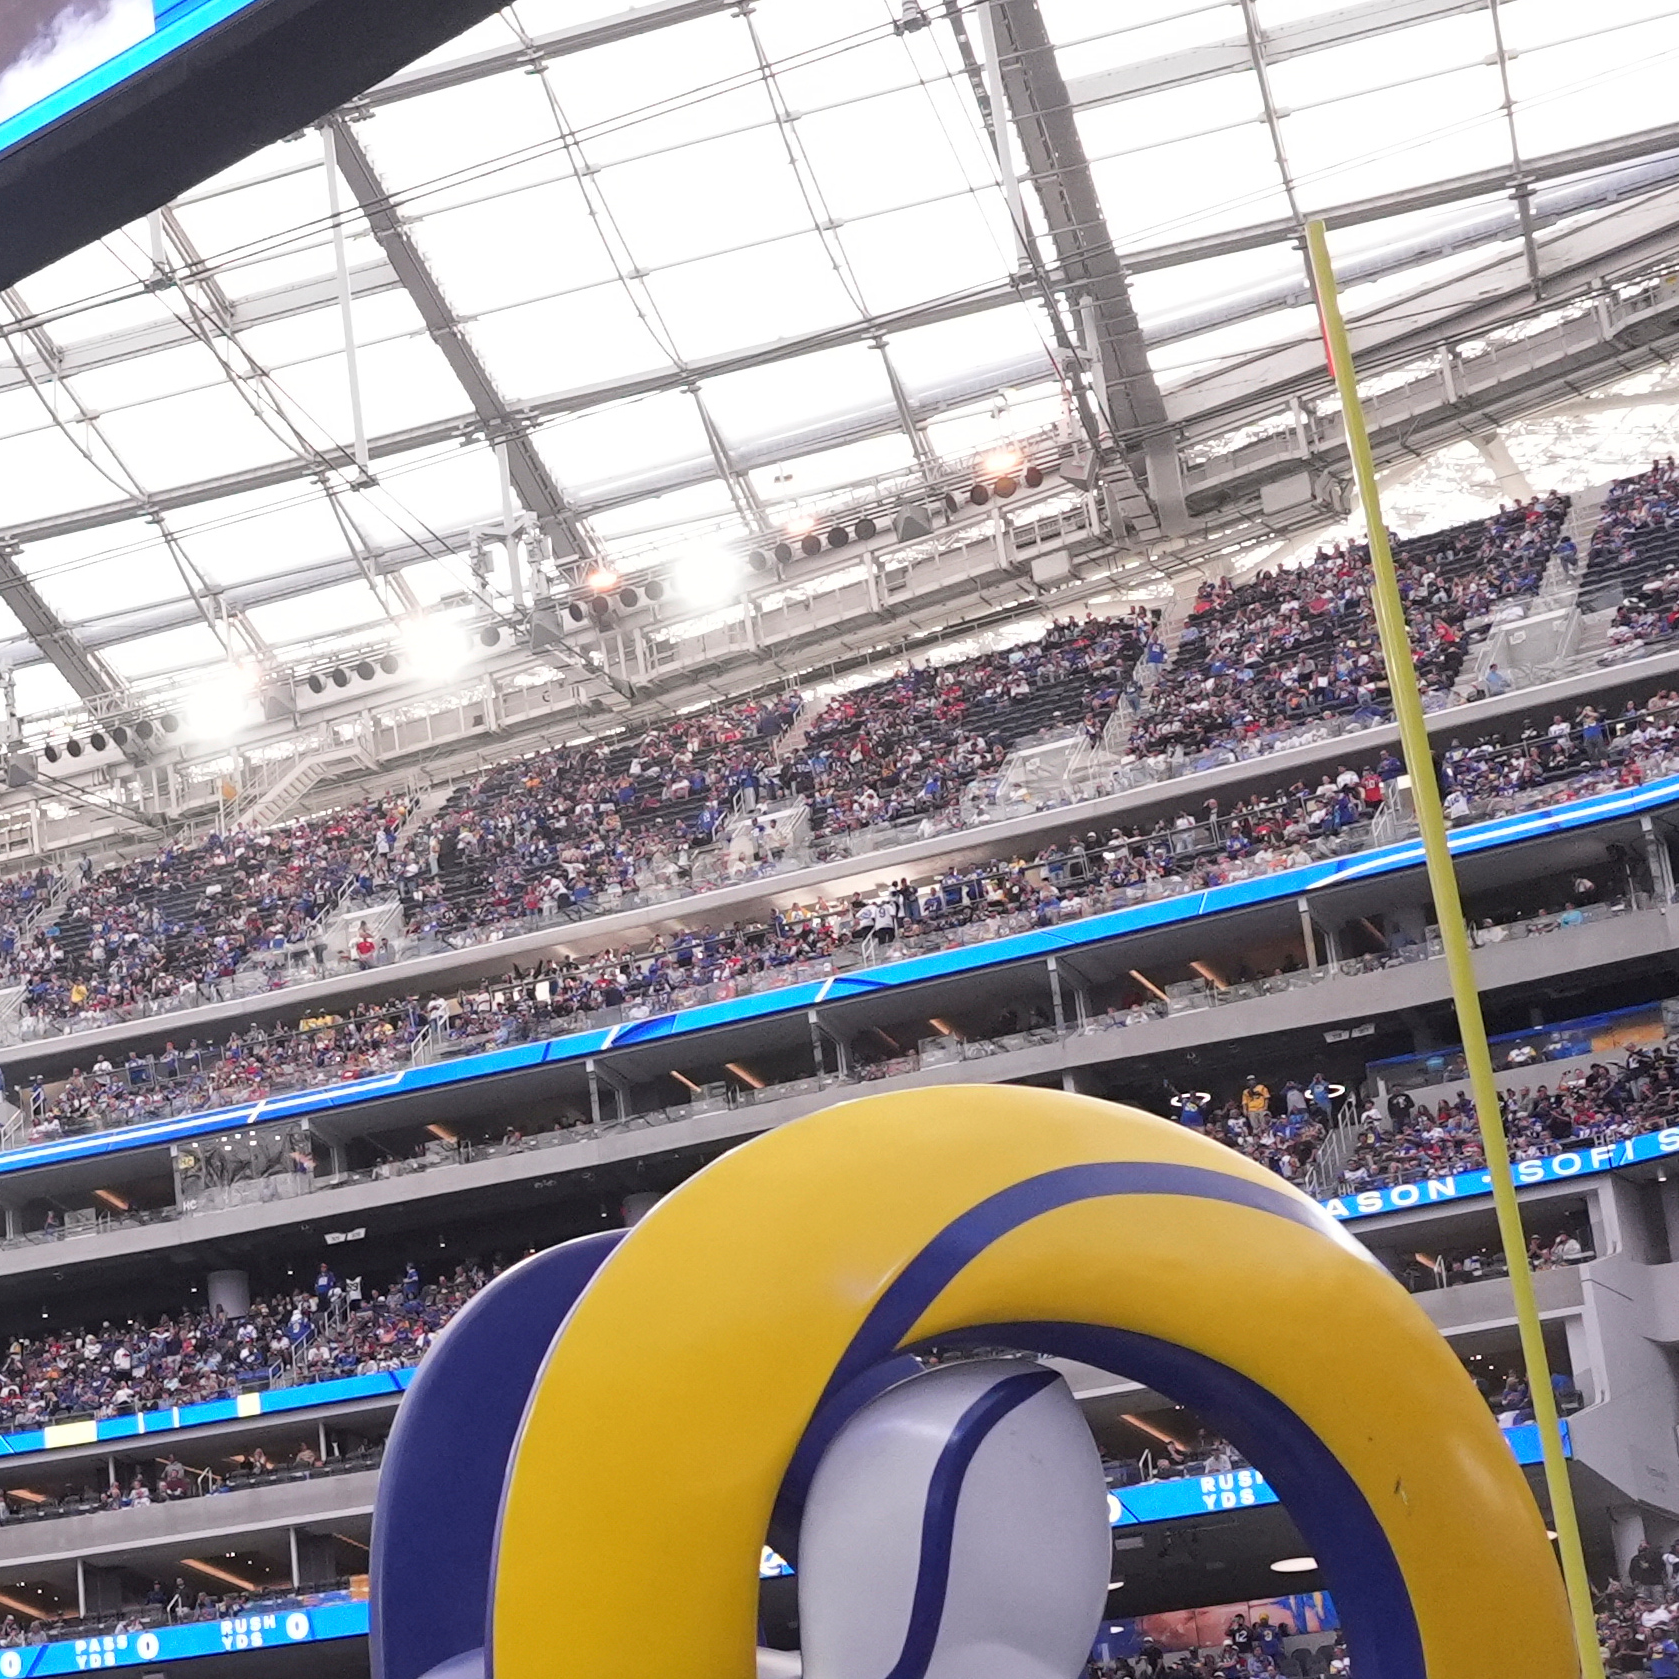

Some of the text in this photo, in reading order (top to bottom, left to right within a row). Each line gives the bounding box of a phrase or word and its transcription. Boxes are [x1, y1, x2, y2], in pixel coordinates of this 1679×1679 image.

[1520, 1140, 1636, 1183] SOFI
[1202, 1488, 1255, 1510] YDS
[75, 1635, 128, 1654] PASS
[221, 1614, 276, 1635] RUSH
[221, 1632, 263, 1651] YDS
[75, 1652, 116, 1669] YDS
